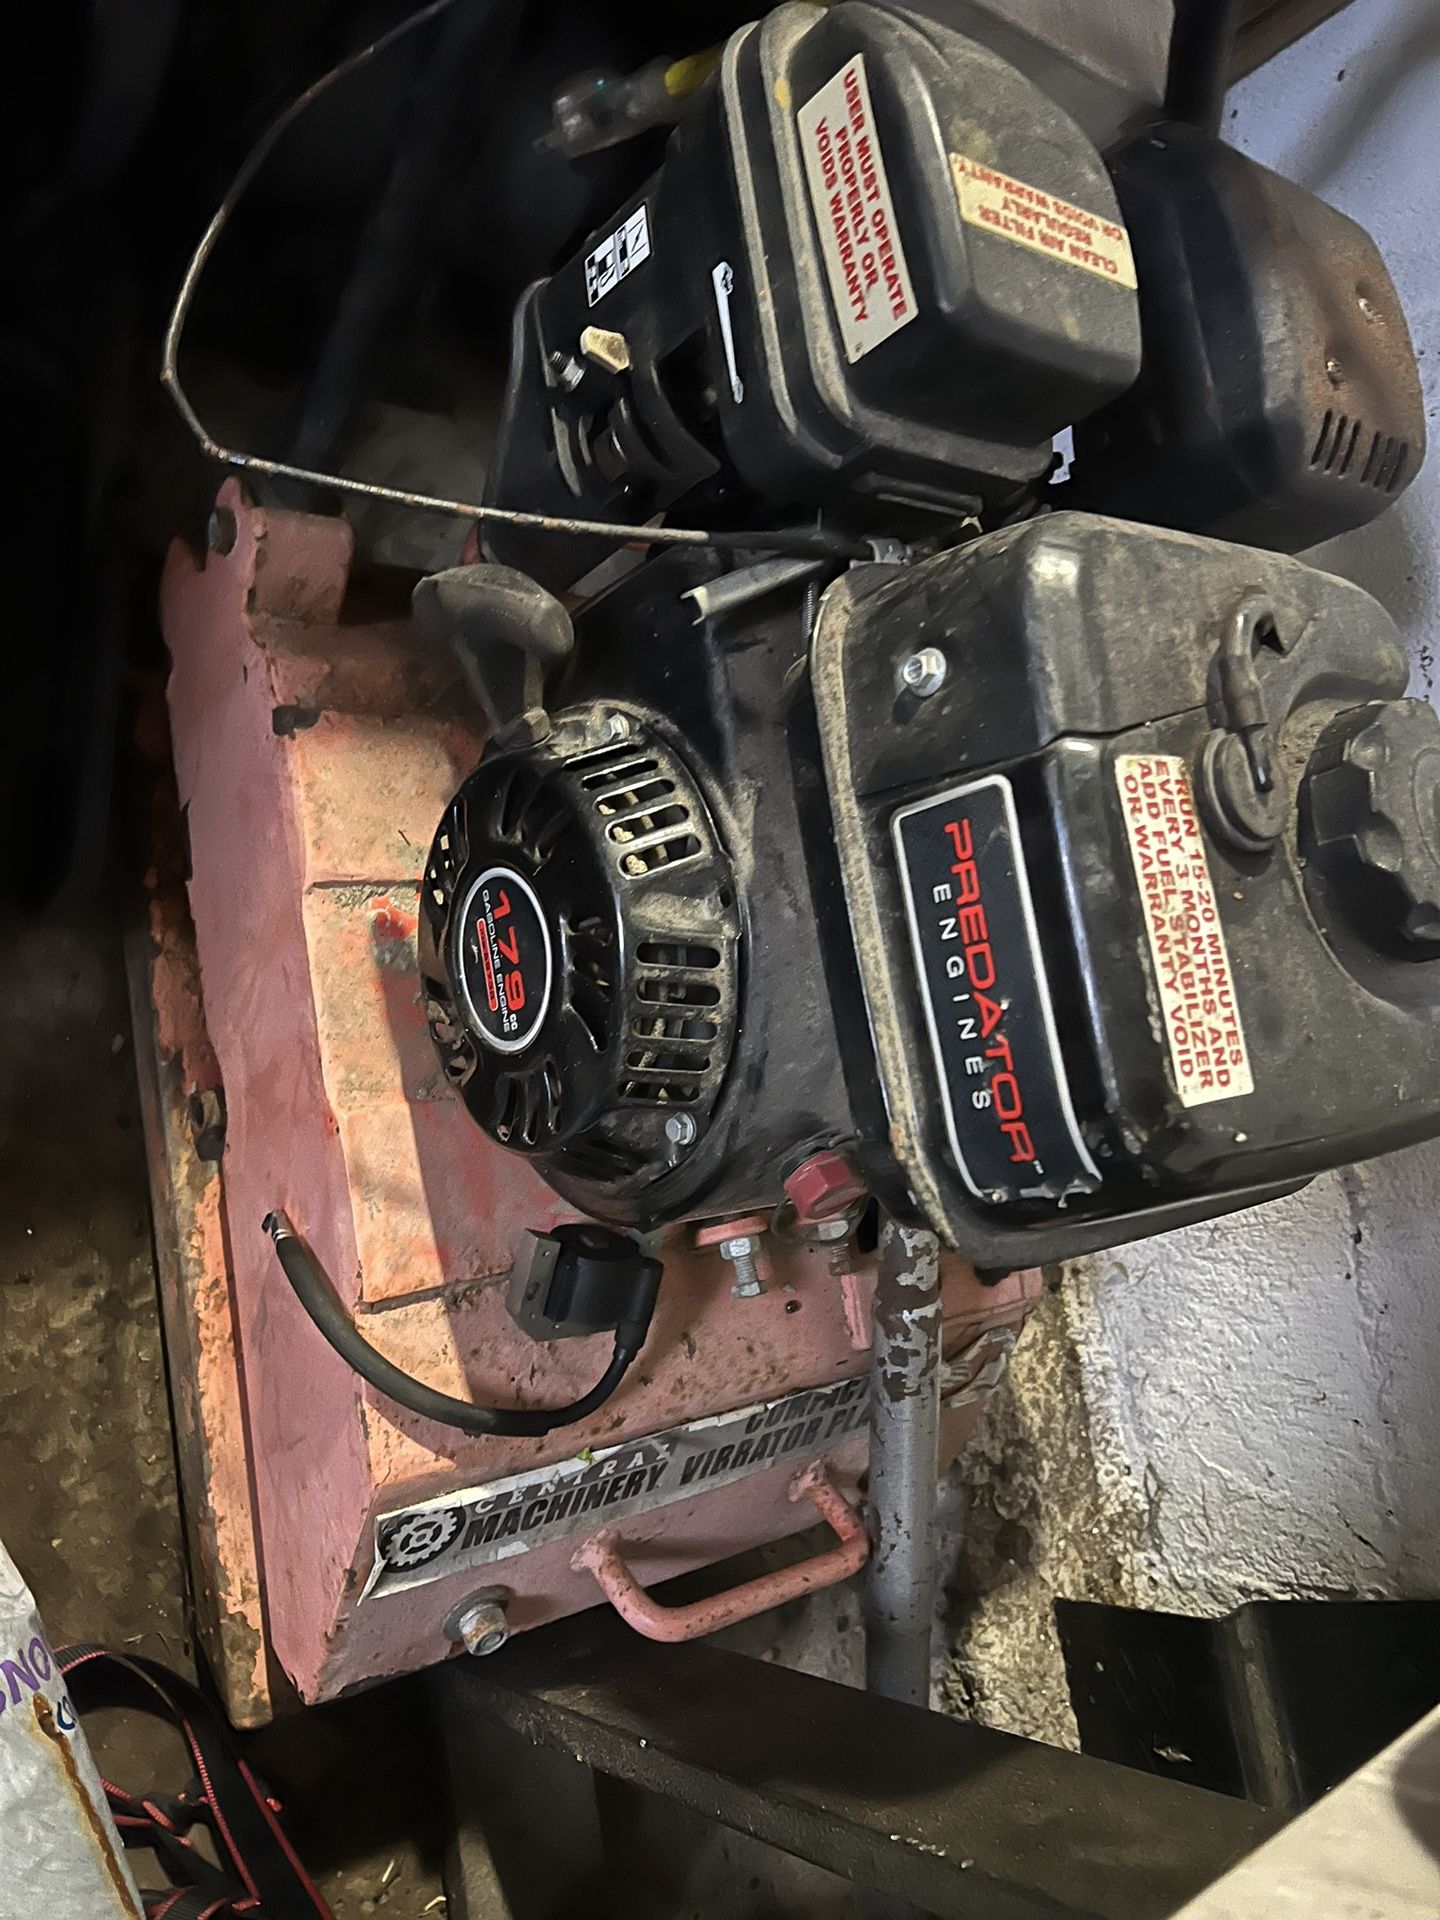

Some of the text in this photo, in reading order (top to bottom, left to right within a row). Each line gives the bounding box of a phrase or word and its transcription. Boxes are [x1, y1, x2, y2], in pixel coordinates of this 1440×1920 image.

[815, 116, 869, 323] VOIDS WARRANTY
[835, 125, 880, 289] PROPERLY OR
[843, 68, 908, 321] USER MUST OPERATE
[978, 204, 1035, 241] FILTER
[1002, 196, 1093, 246] REGULARLY
[1068, 243, 1118, 275] CLEAN
[482, 889, 501, 970] GASOLINE
[496, 972, 511, 1033] ENGINE
[492, 888, 526, 1012] 179
[933, 883, 991, 1110] ENGINES
[944, 818, 1038, 1164] PREDATOR
[1124, 774, 1194, 1077] OR WARRANTY VOID
[1137, 762, 1214, 1089] ADD FUEL STABILIZER
[1155, 760, 1231, 1087] EVERY 3 MONTHS AND
[1174, 778, 1243, 1066] RUN 15-20 MINUTES
[461, 1461, 669, 1550] MACHINERY
[679, 1416, 824, 1486] VIBRATOR
